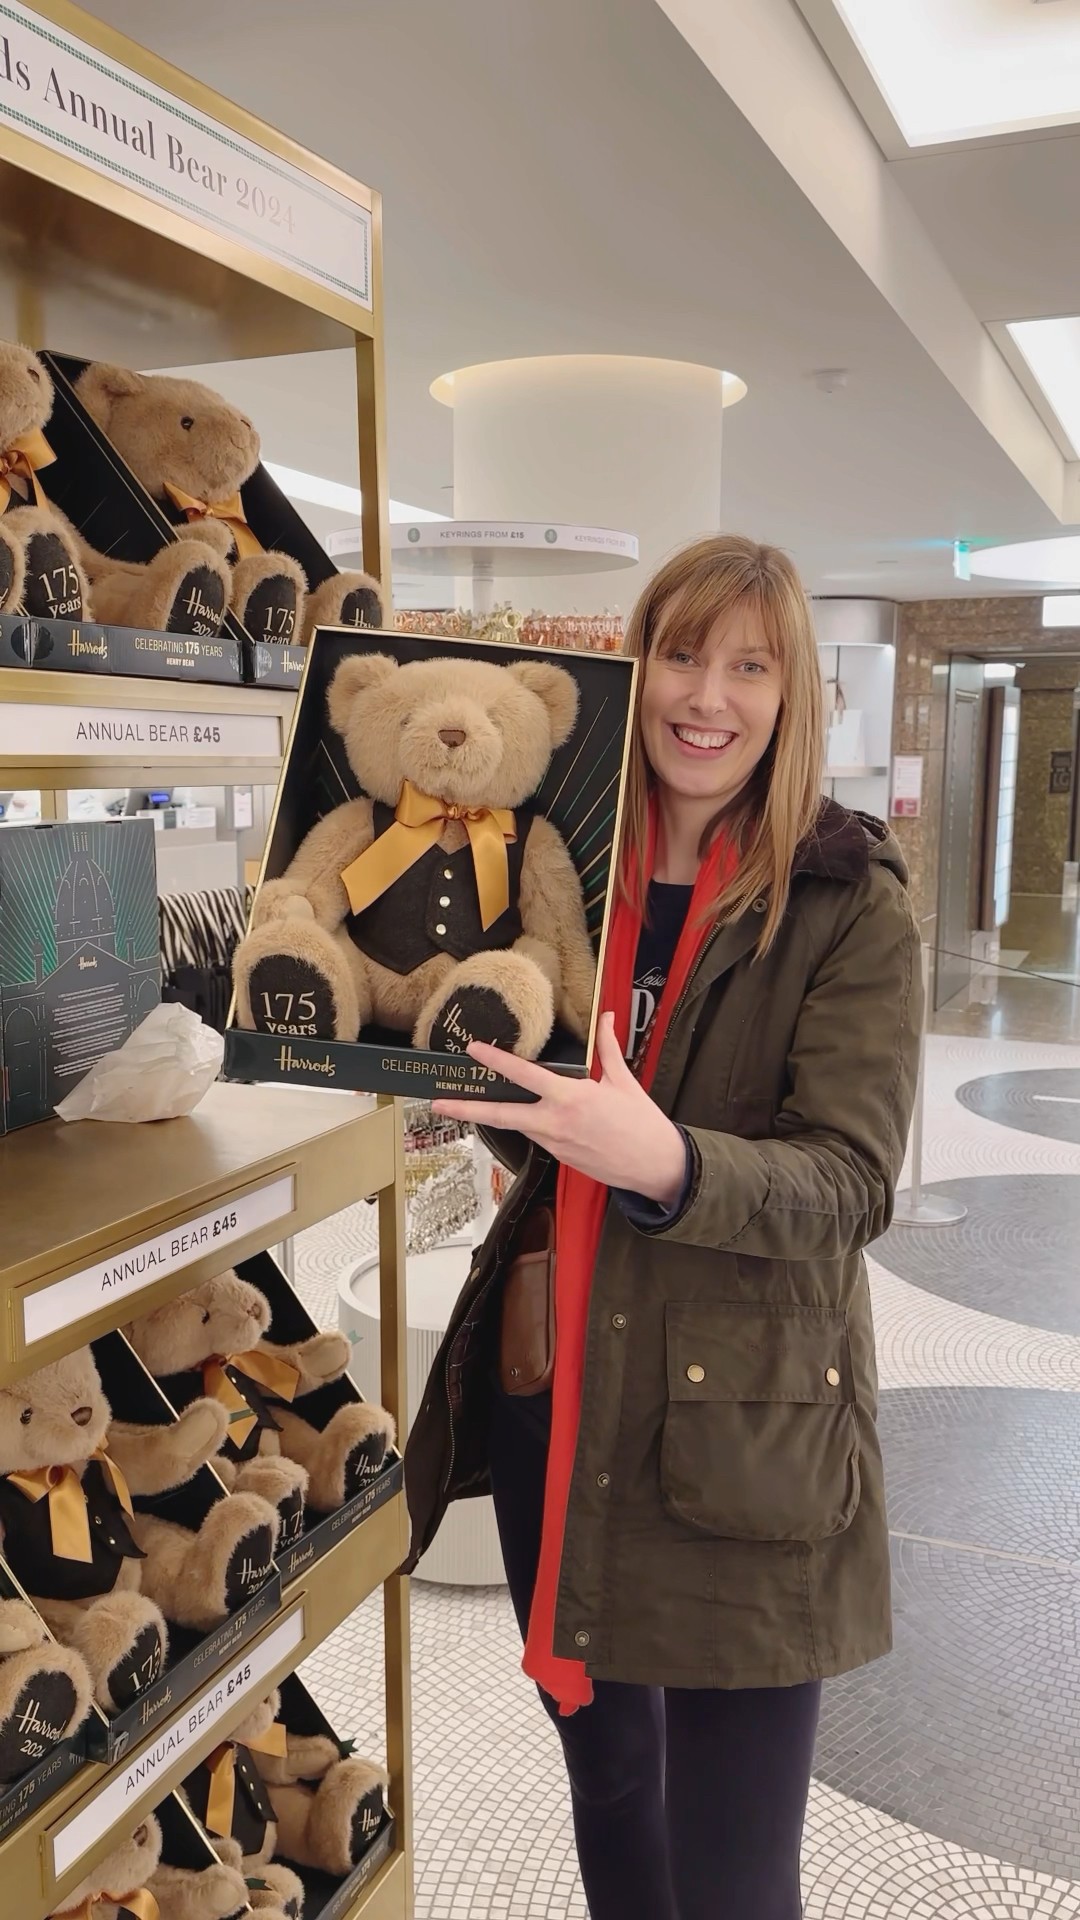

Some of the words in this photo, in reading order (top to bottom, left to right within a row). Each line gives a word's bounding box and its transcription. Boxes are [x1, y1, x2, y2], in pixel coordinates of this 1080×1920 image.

[43, 67, 156, 160] Annual
[166, 133, 228, 197] Bear
[235, 177, 296, 235] 2024
[39, 564, 79, 602] 175
[263, 606, 295, 634] 175
[67, 629, 108, 659] Harrods
[135, 637, 184, 654] CELEBRATING
[184, 642, 200, 656] 175
[201, 645, 223, 658] YEARS
[166, 657, 182, 667] HENRY
[76, 722, 145, 741] ANNUAL
[149, 724, 189, 742] BEAR
[193, 726, 221, 743] £45
[260, 991, 316, 1021] 175
[265, 1021, 317, 1036] years
[274, 1045, 336, 1077] Harrods
[381, 1058, 466, 1079] CELEBRATING
[470, 1066, 496, 1082] 175
[435, 1081, 462, 1091] HENRY
[464, 1084, 486, 1094] BEAR
[101, 1248, 166, 1291] ANNUAL
[171, 1226, 208, 1257] BEAR
[212, 1212, 237, 1238] £45
[365, 1488, 376, 1504] 175
[280, 1511, 302, 1537] 17
[193, 1626, 234, 1668] CELEBRATING
[235, 1612, 247, 1631] 175
[248, 1596, 266, 1618] YEARS
[139, 1686, 172, 1725] Harrods
[126, 1730, 185, 1795] ANNUAL
[188, 1690, 223, 1734] BEAR
[227, 1664, 251, 1697] £45
[19, 1779, 36, 1803] 175
[38, 1756, 62, 1785] YEARS
